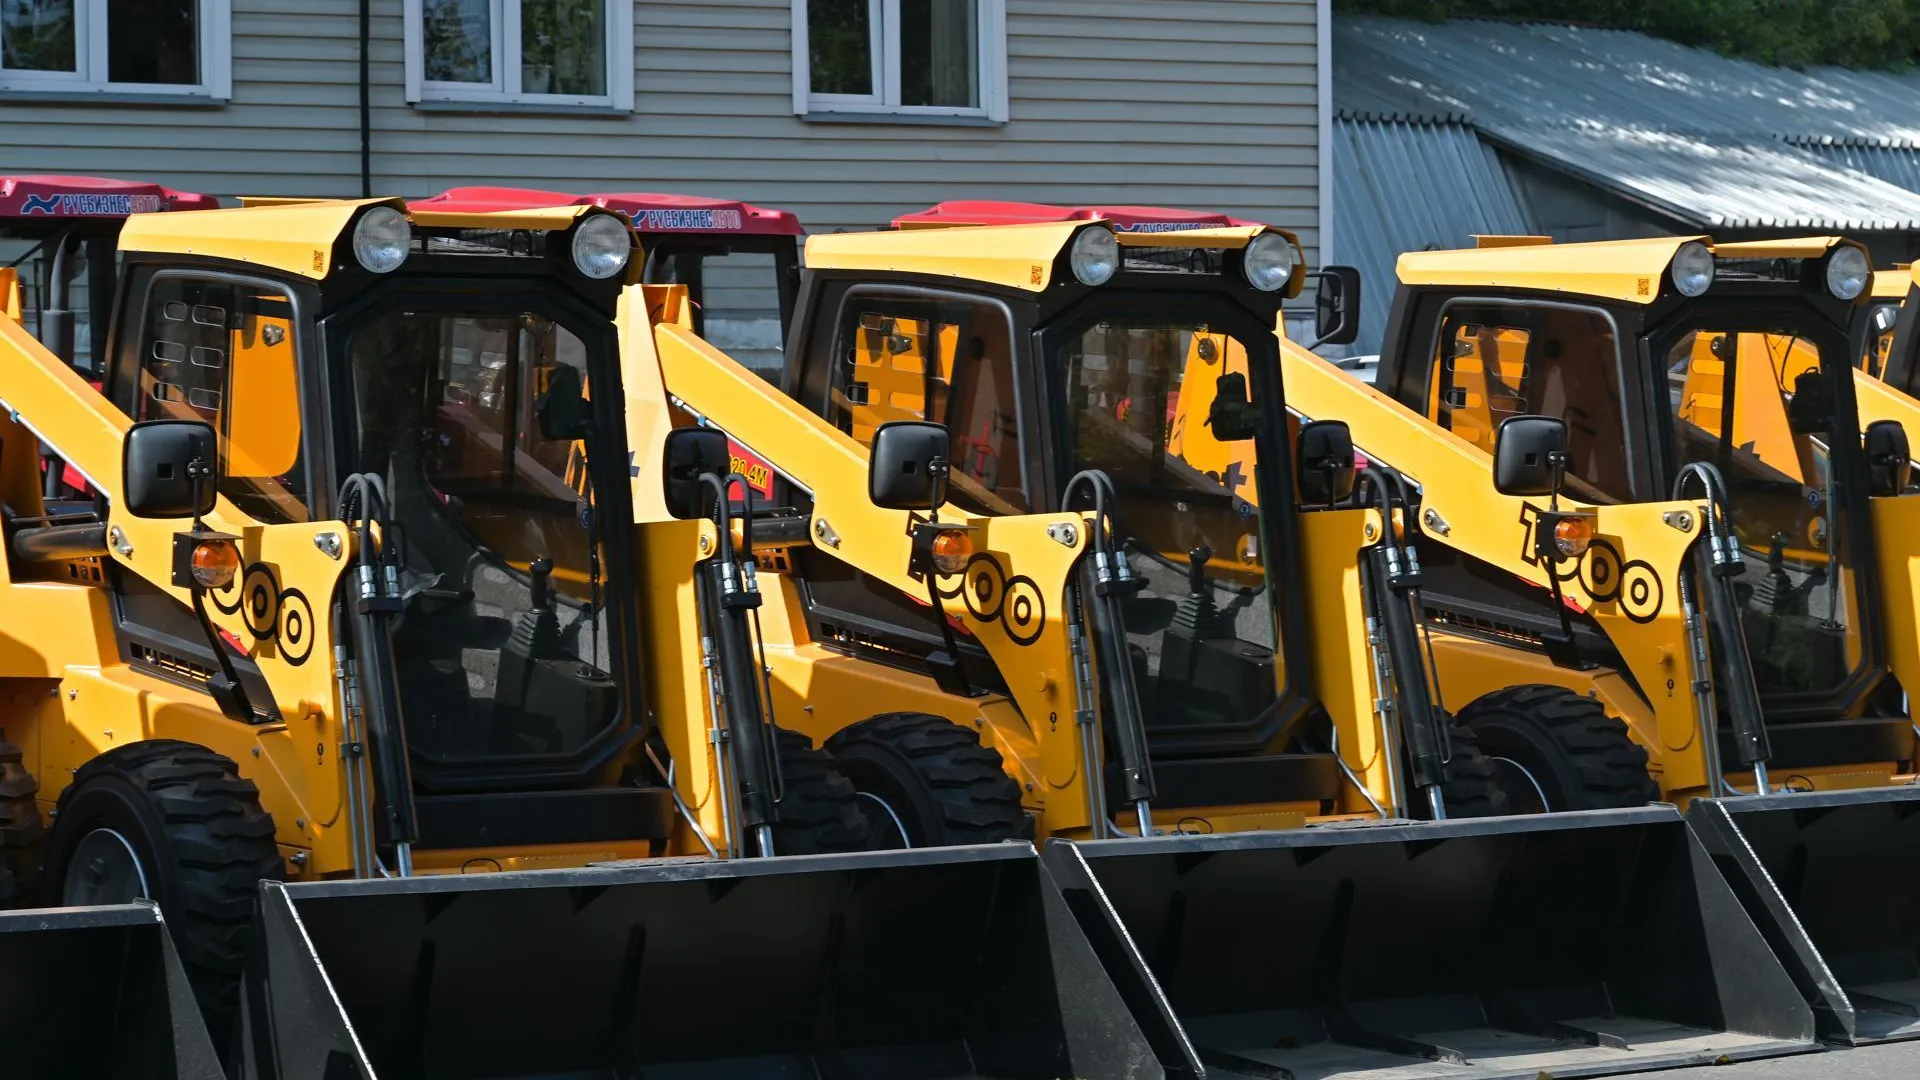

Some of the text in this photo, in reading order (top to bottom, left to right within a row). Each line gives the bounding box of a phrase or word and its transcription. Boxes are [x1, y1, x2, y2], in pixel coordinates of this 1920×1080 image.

[649, 209, 743, 230] РУСБИЗНЕСАВТО
[730, 455, 768, 489] 20.4M
[1519, 500, 1664, 624] 100
